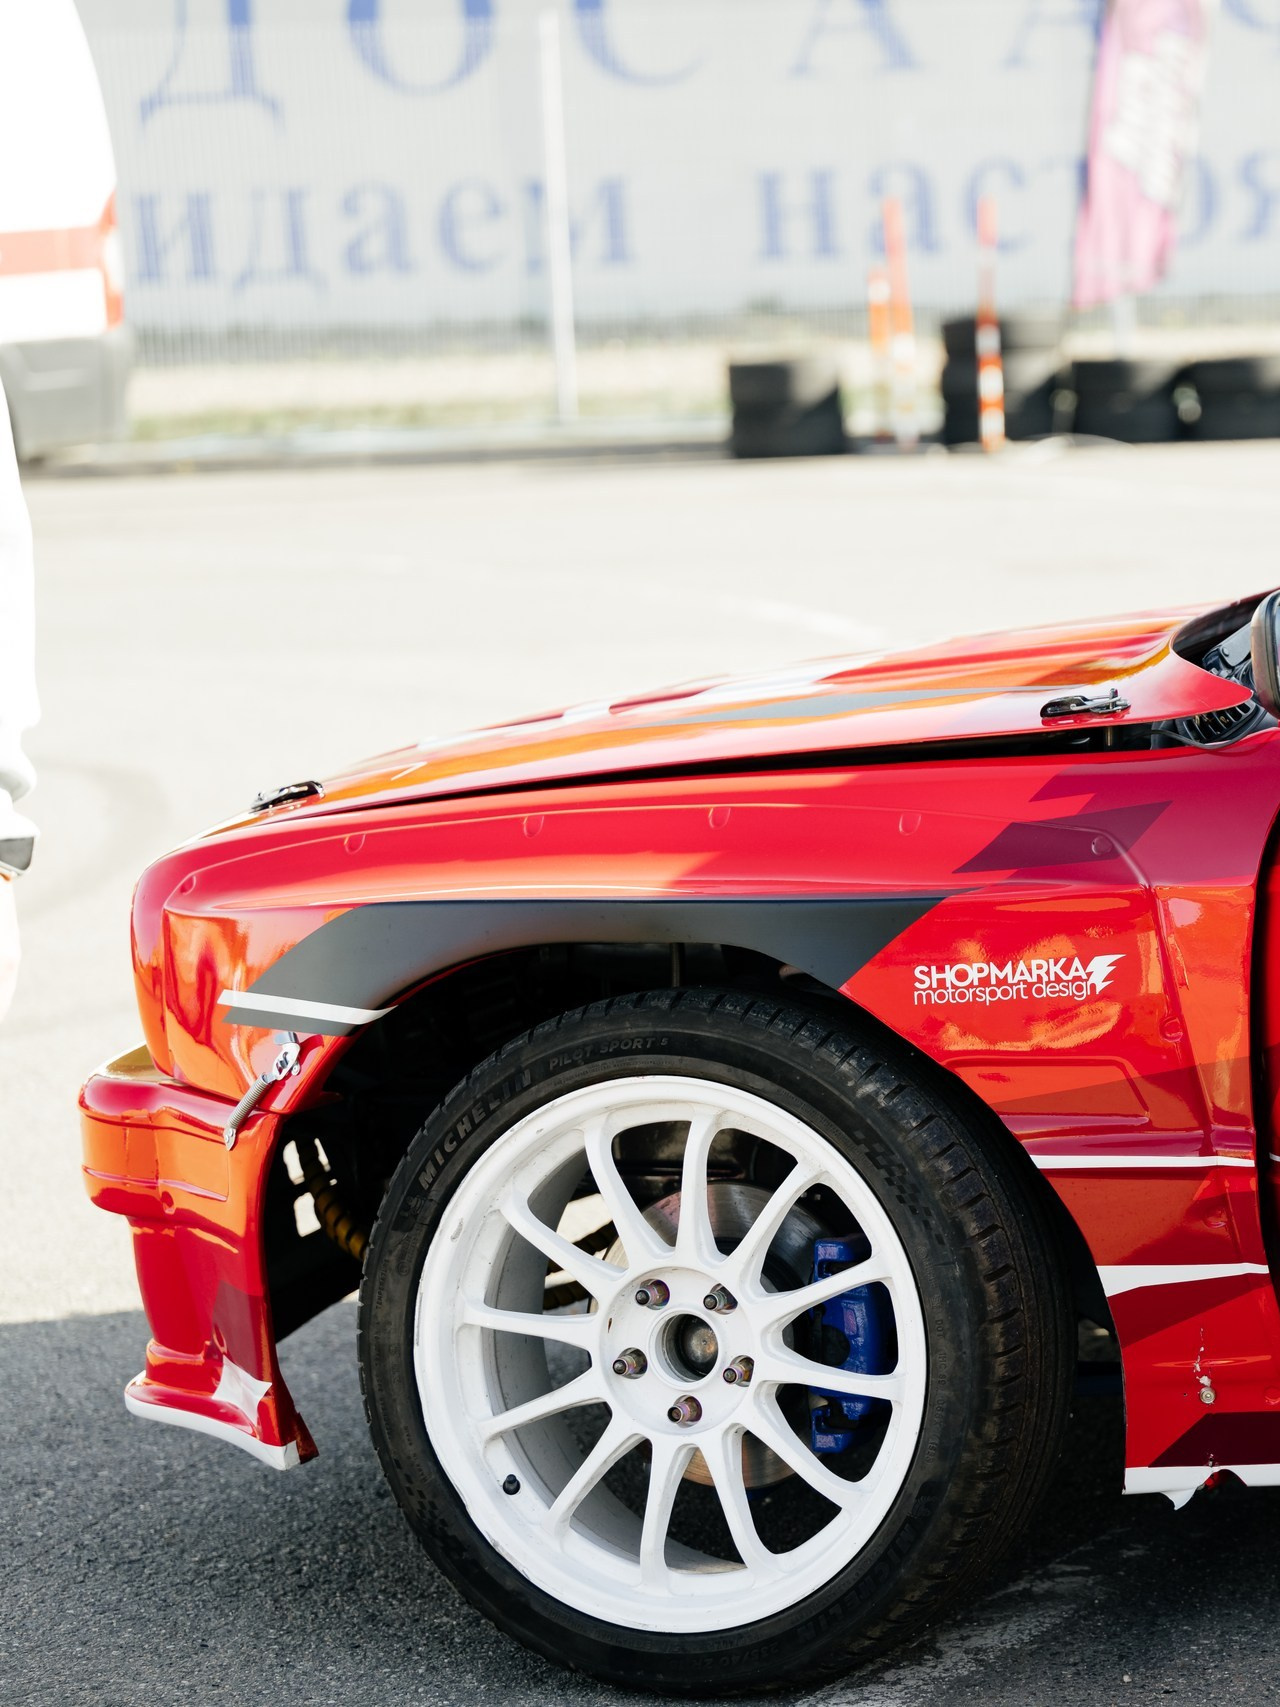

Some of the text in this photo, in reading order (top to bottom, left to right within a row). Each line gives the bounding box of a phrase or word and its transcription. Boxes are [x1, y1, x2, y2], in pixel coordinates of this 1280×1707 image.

[913, 956, 1088, 989] SHOPMARKA
[913, 976, 1100, 1006] motorsport design
[417, 1068, 533, 1191] MICHELIN
[548, 1045, 595, 1071] PILOT
[599, 1037, 656, 1054] SPORT
